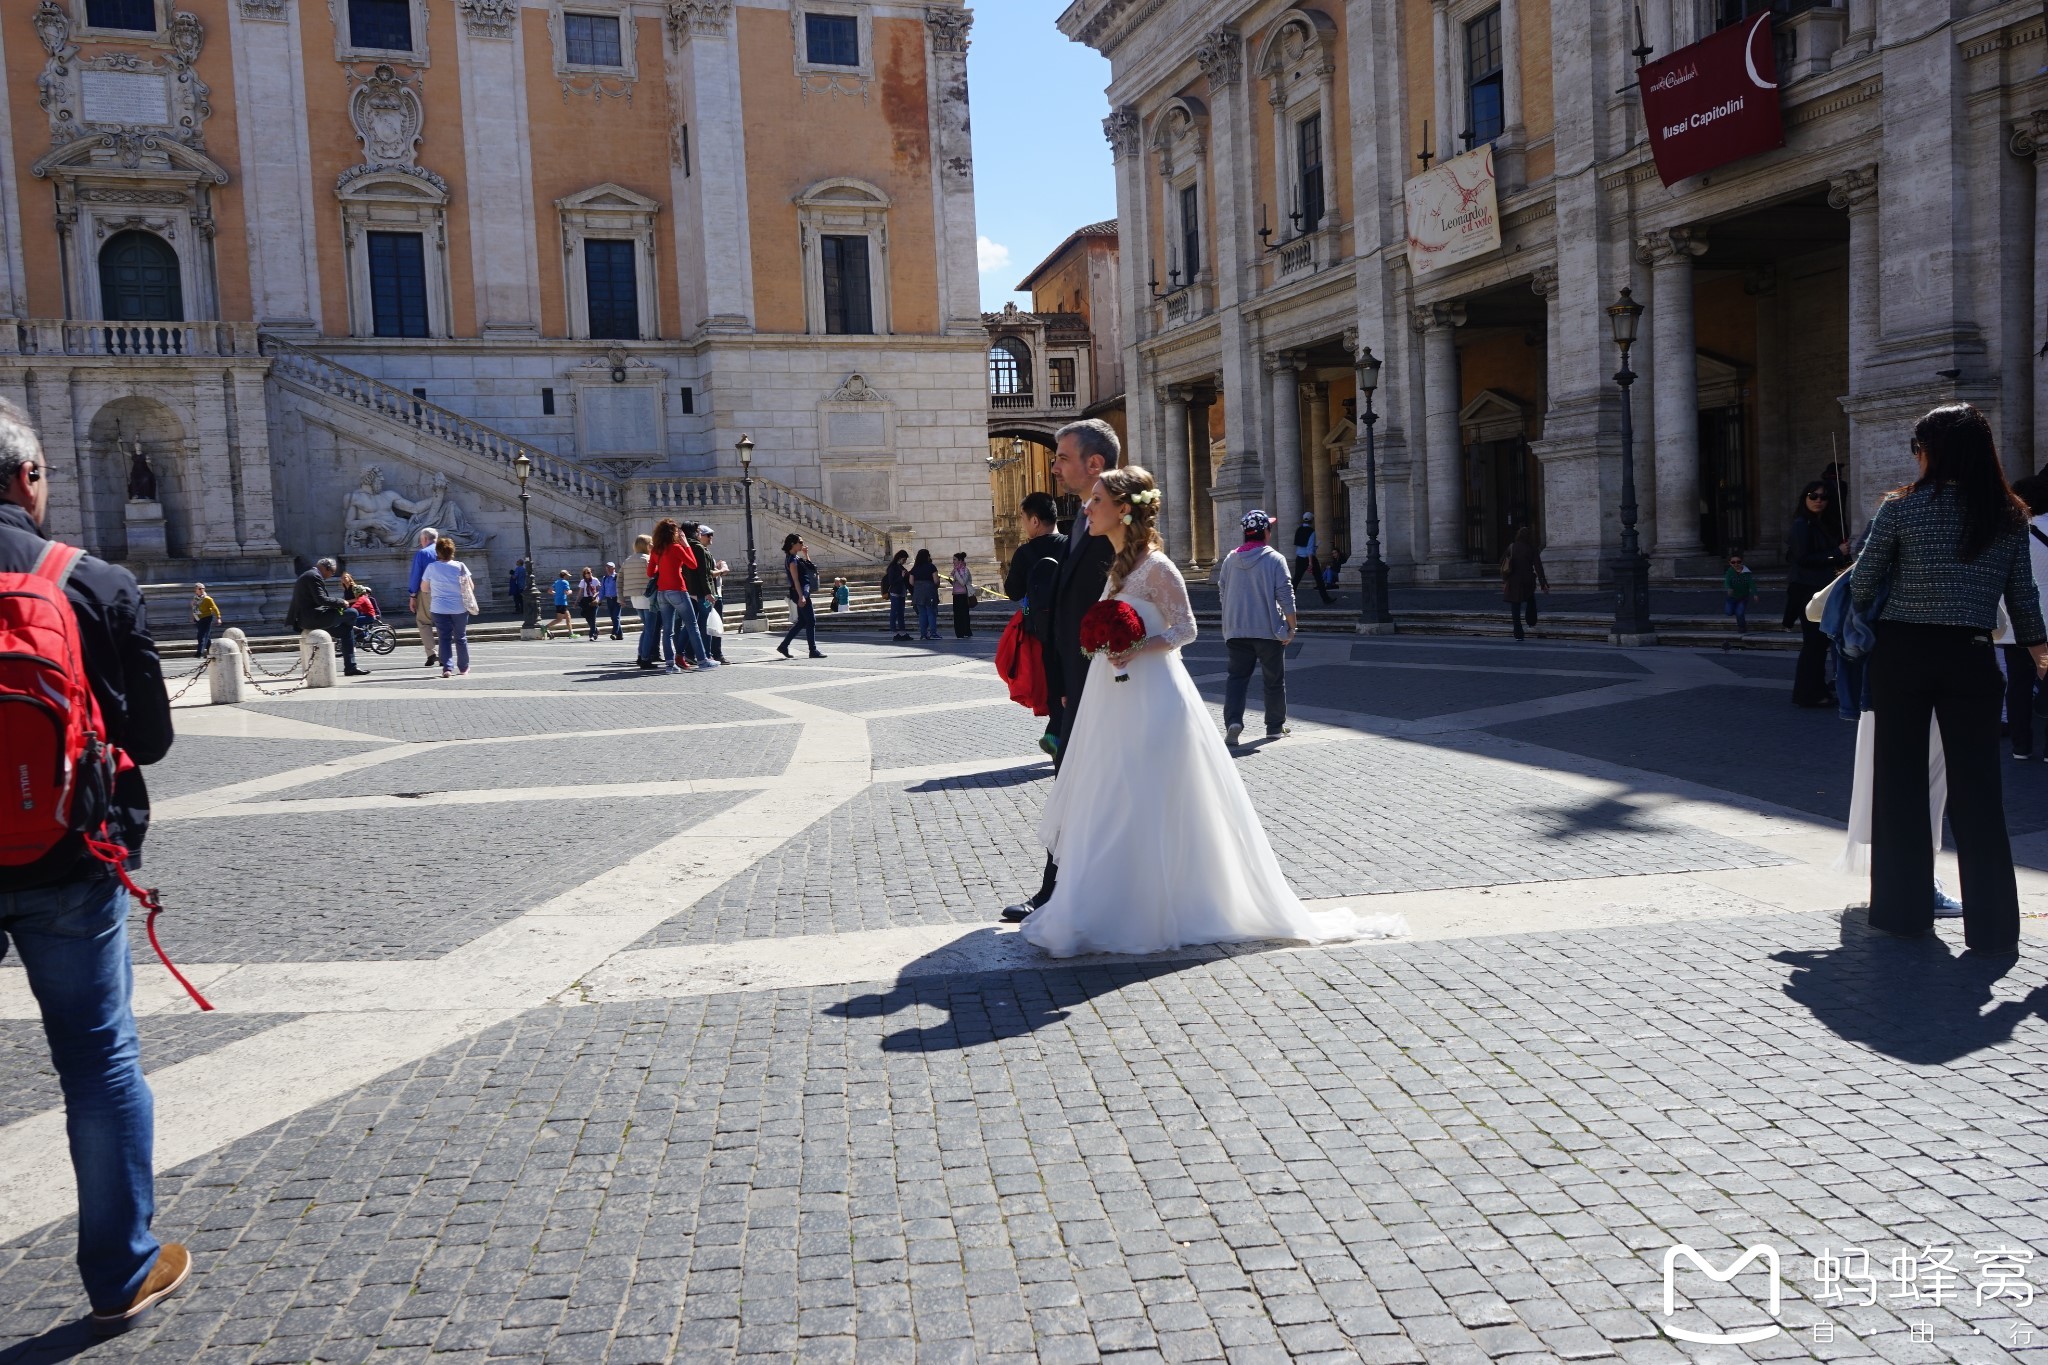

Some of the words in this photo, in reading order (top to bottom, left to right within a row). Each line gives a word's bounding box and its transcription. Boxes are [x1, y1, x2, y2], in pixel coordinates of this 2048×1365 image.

[1690, 95, 1744, 127] Capitolini
[1441, 205, 1484, 232] Leonardo
[1474, 206, 1493, 229] volo
